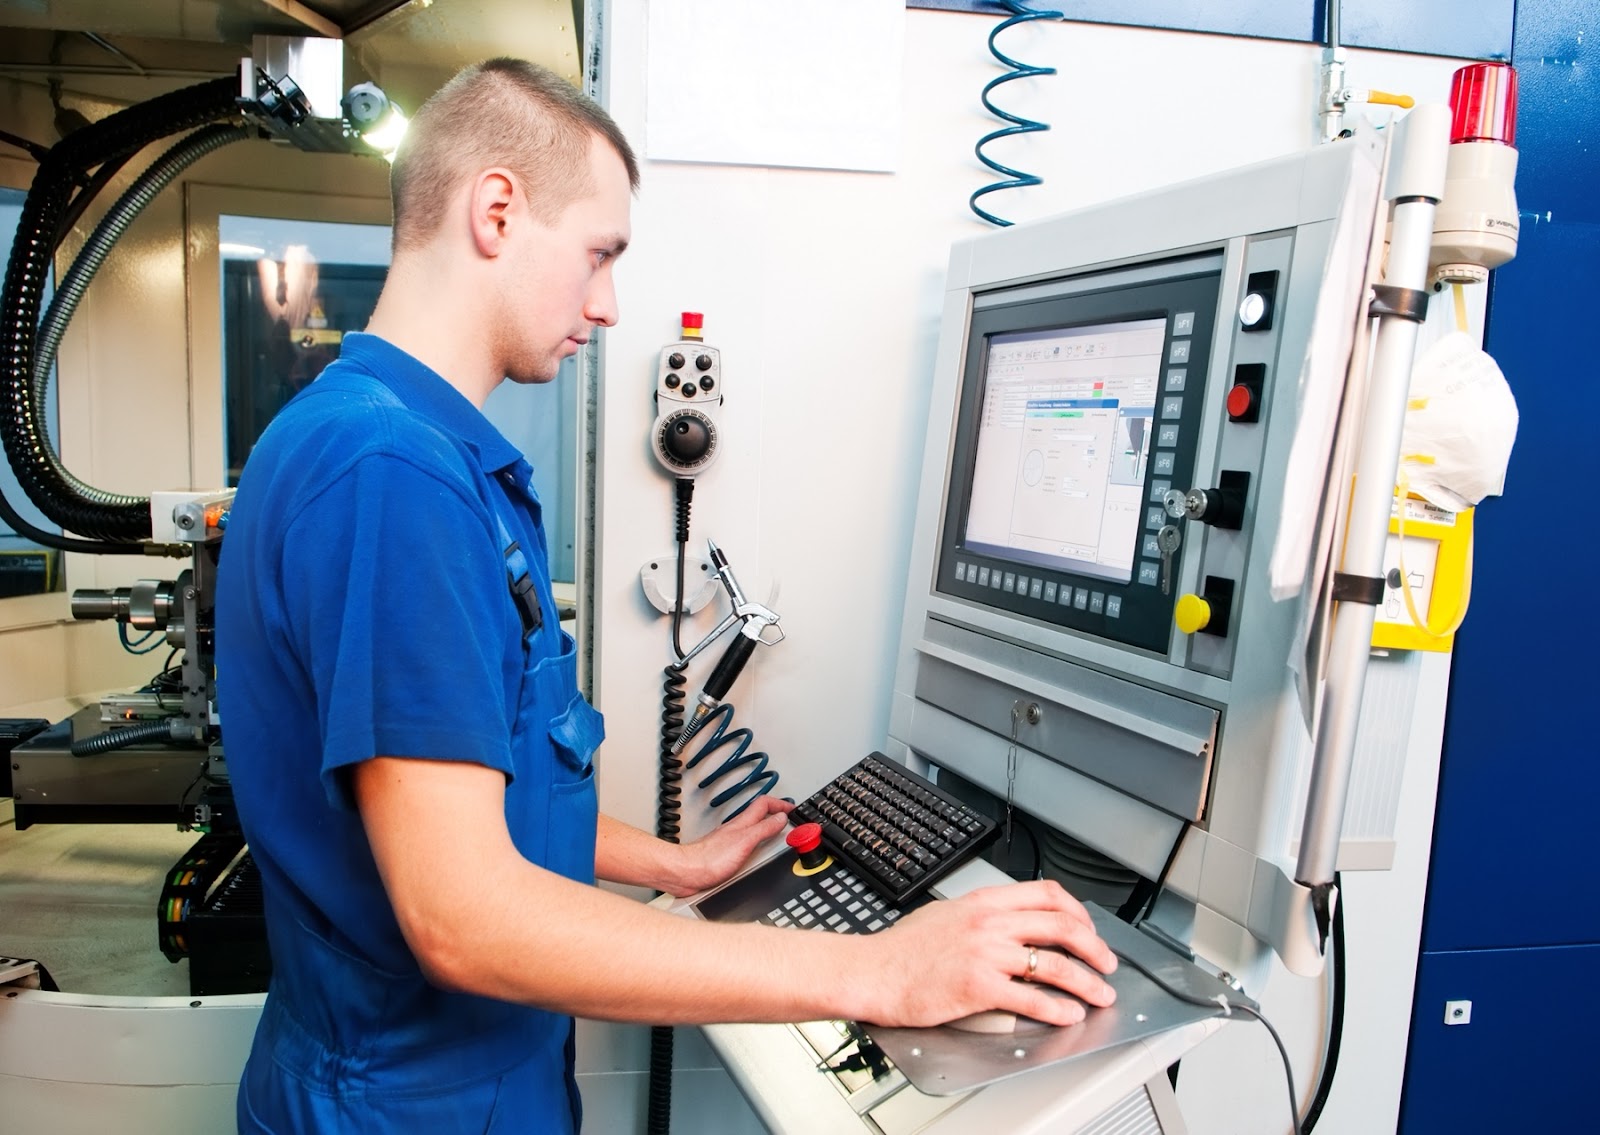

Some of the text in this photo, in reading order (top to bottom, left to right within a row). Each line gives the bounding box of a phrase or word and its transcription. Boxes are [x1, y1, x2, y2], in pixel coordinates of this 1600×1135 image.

[1178, 319, 1190, 329] sF1
[1174, 348, 1186, 357] sF2
[1170, 375, 1182, 384] sF3
[1166, 403, 1178, 412] sF4
[1162, 431, 1175, 440] sF5
[1158, 459, 1170, 468] sF6
[1155, 486, 1167, 495] sF7
[1141, 568, 1156, 579] sF10
